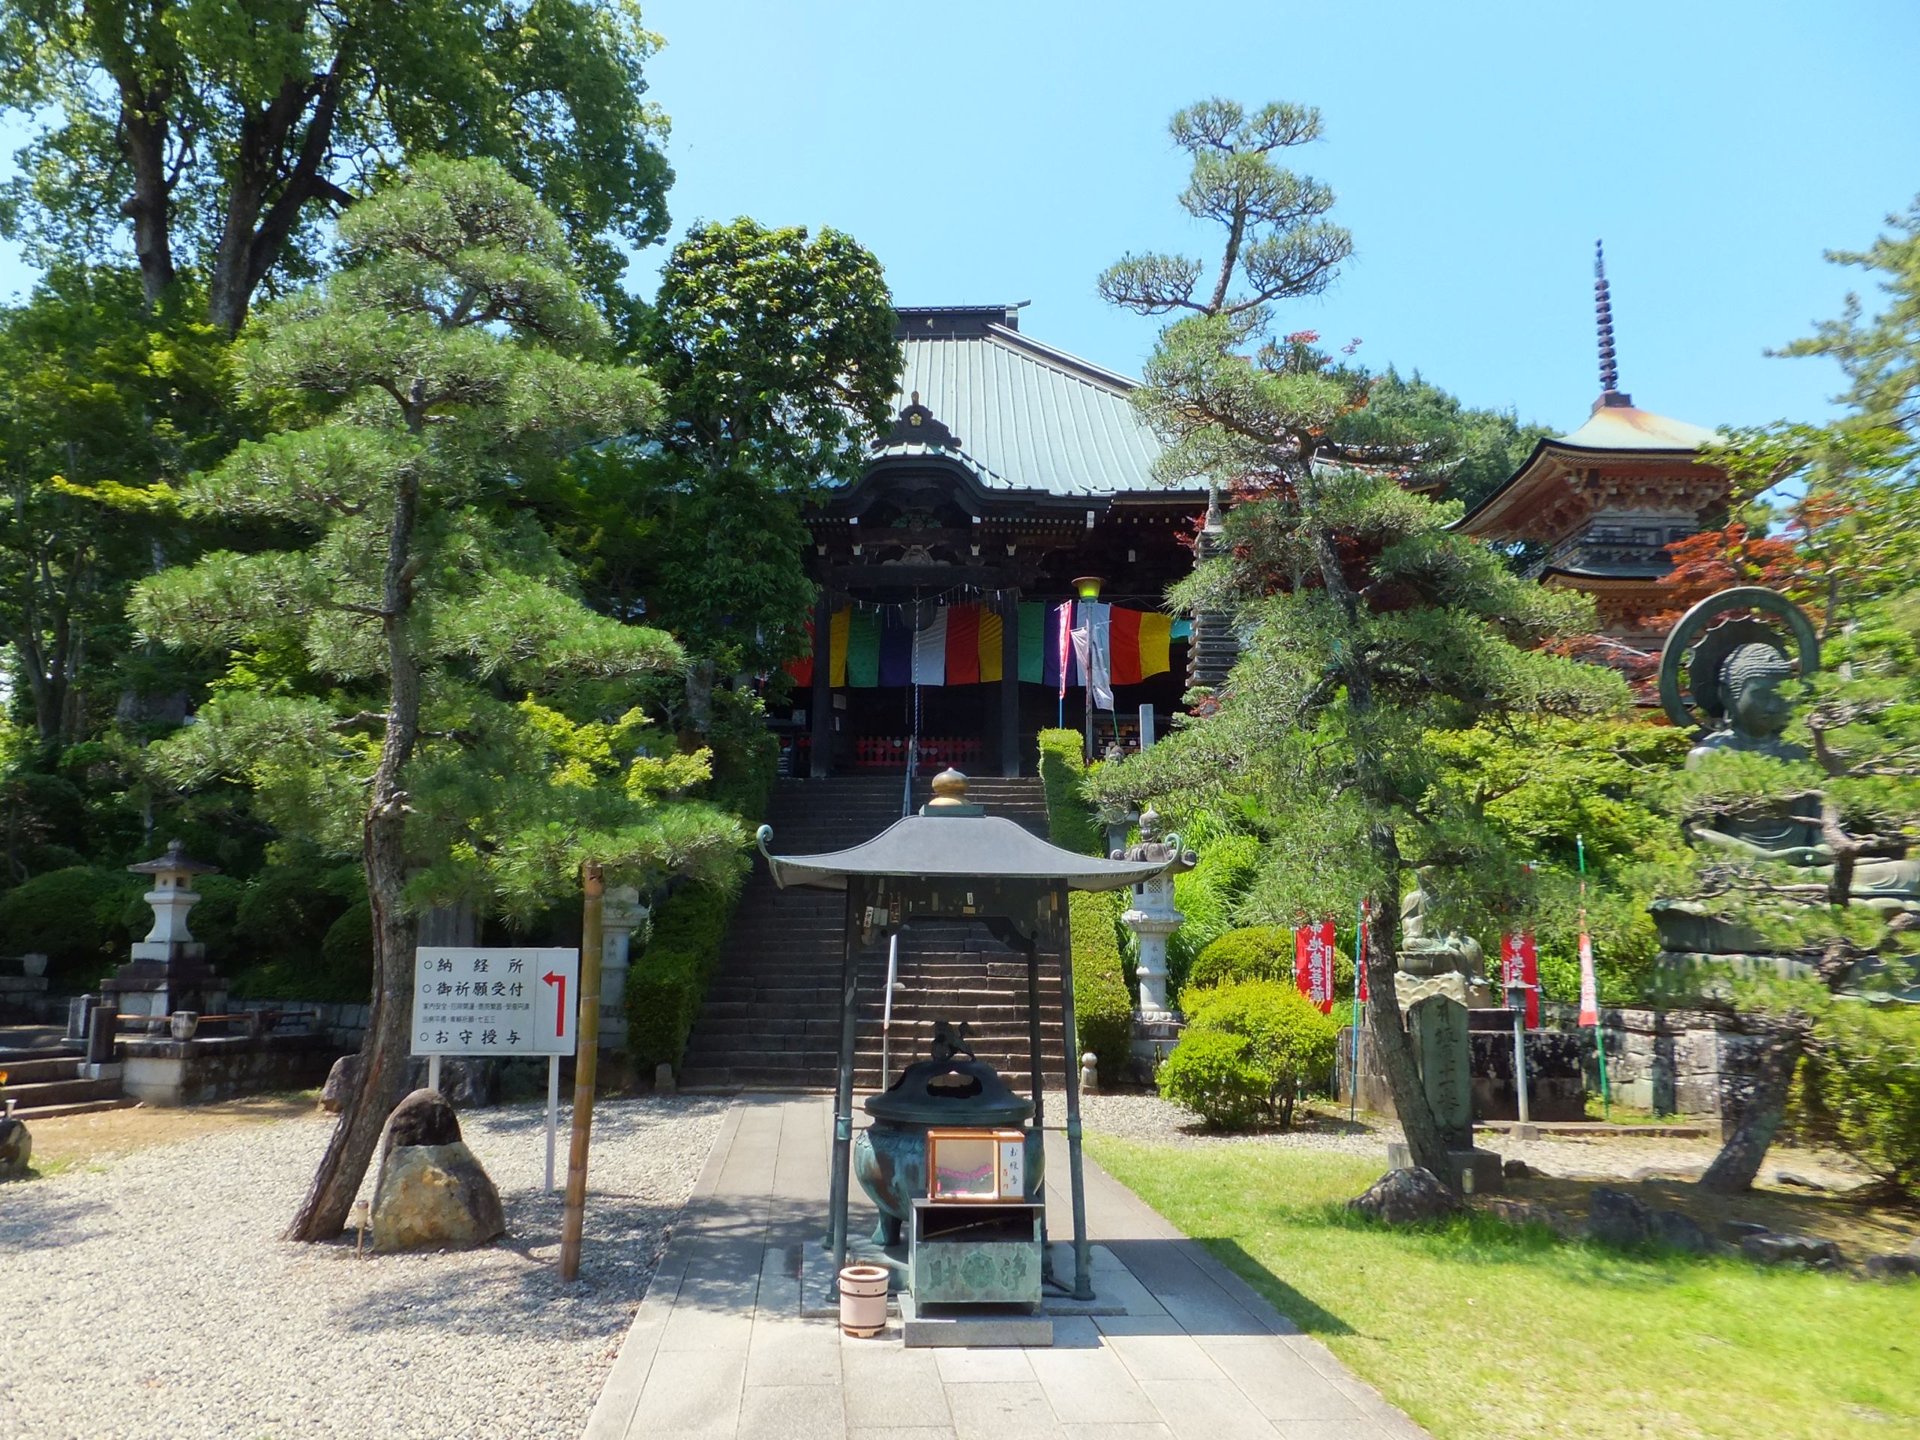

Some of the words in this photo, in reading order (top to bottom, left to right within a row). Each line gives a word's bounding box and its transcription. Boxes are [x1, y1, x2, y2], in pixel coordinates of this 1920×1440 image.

[437, 958, 524, 974] 納経所
[437, 981, 523, 997] 御祈願受付
[435, 1029, 521, 1045] お守授与
